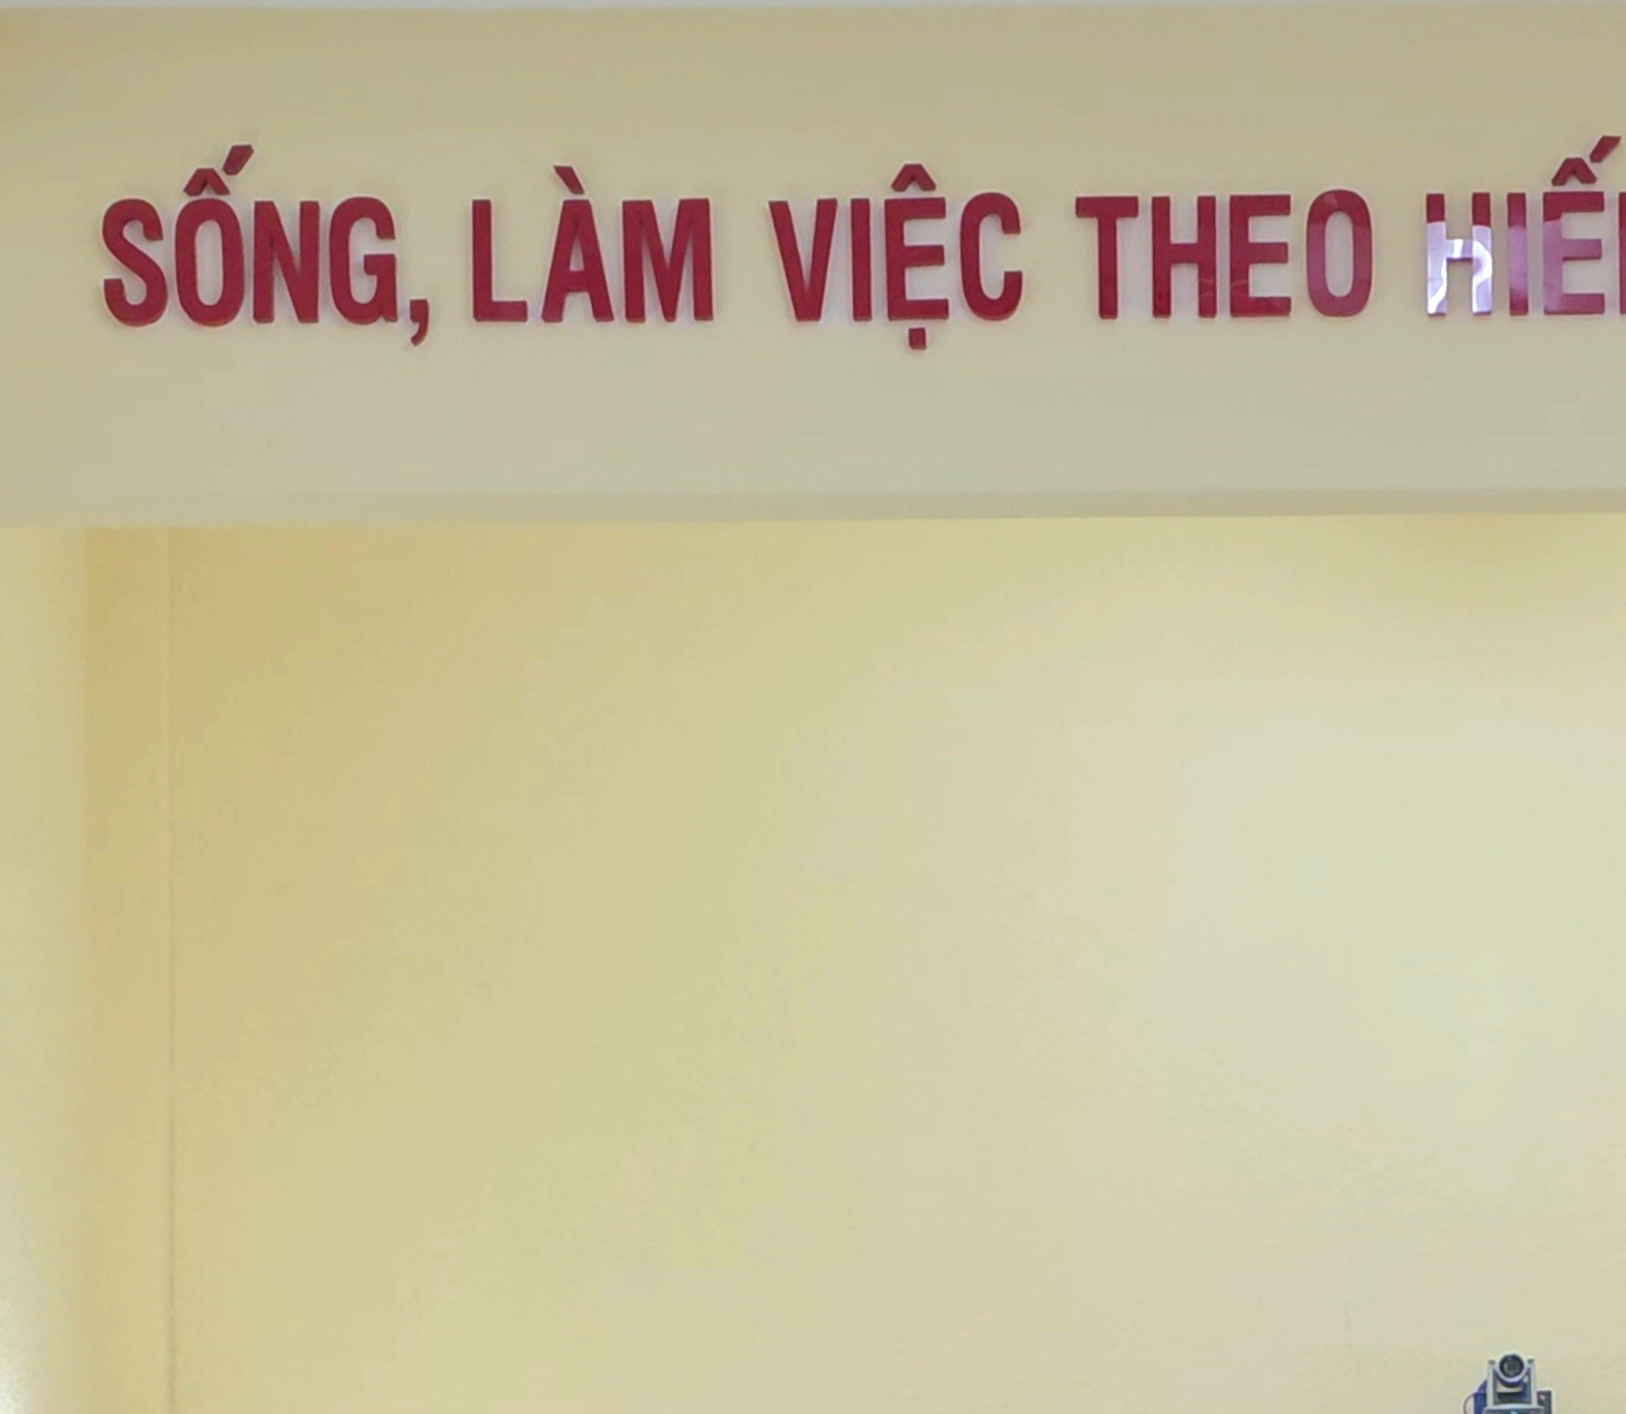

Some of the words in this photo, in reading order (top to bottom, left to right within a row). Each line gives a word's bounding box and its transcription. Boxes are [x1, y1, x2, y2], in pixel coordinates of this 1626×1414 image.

[102, 145, 429, 342] SỐNG,
[472, 167, 713, 323] LÀM
[769, 163, 1024, 349] VIỆC
[1075, 189, 1372, 319] THEO
